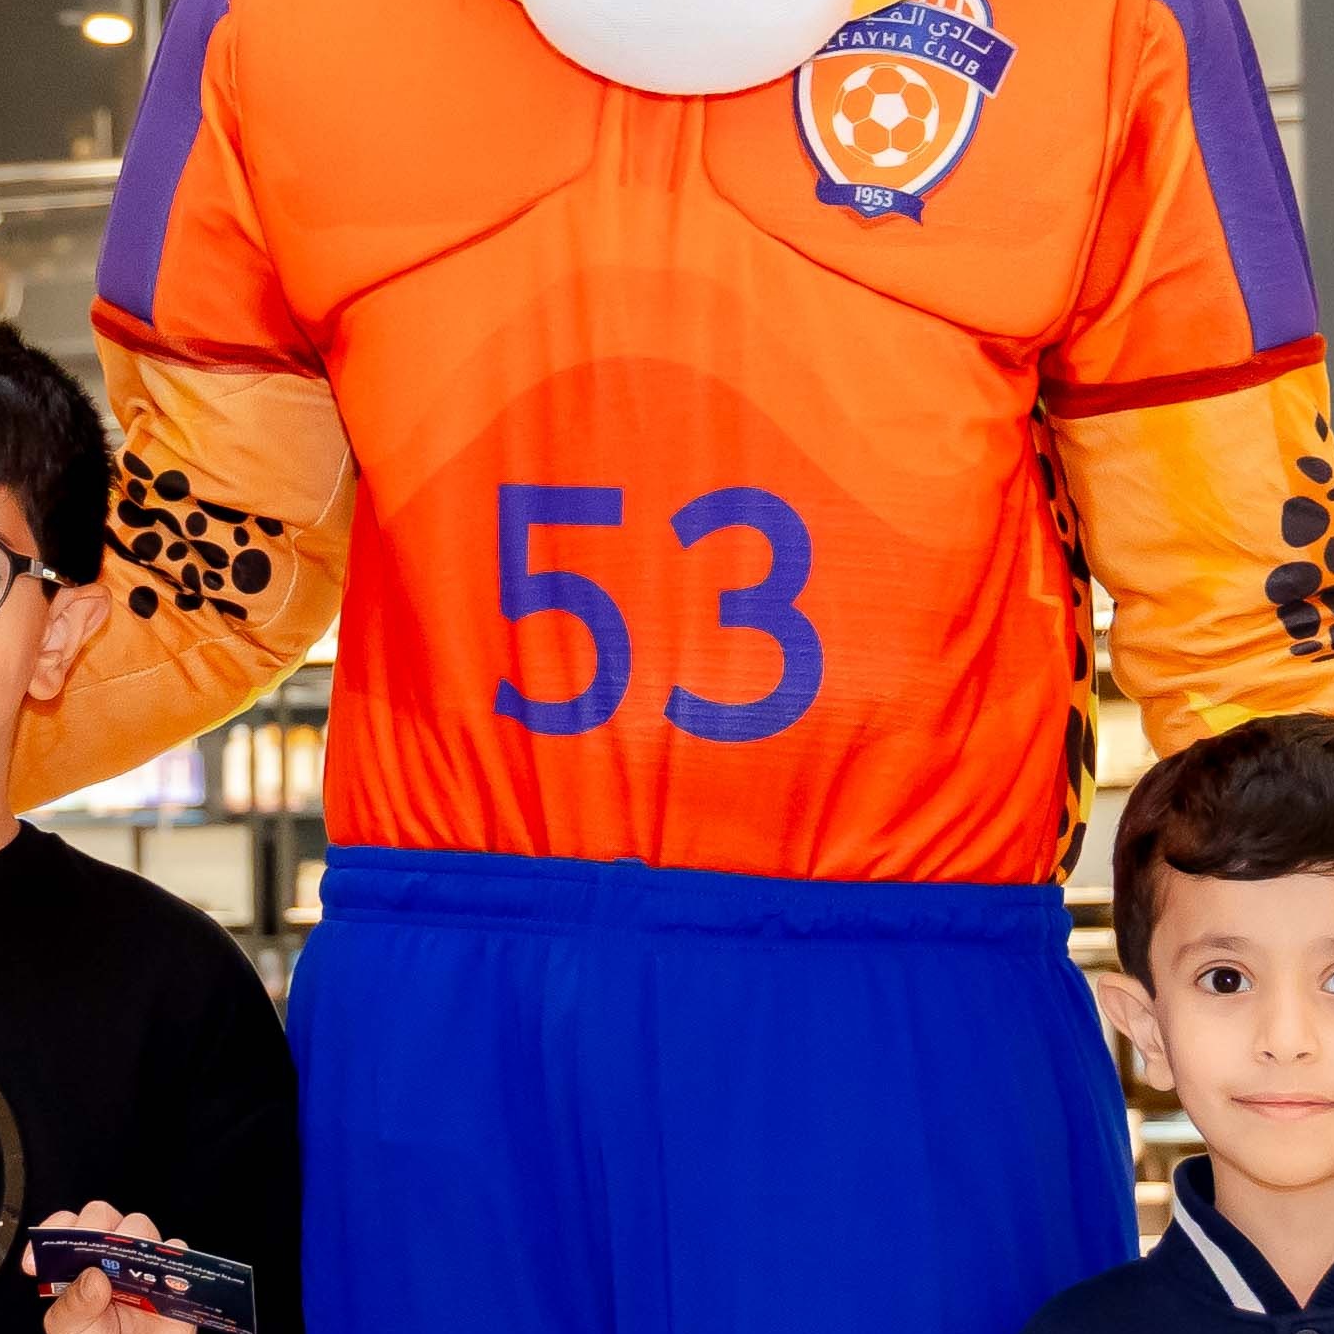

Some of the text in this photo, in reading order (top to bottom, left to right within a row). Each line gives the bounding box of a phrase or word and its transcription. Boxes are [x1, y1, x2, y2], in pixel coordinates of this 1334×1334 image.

[826, 30, 981, 77] FAYHA CLUB
[928, 21, 996, 55] نادي
[854, 186, 894, 207] 1953
[493, 482, 825, 744] 53
